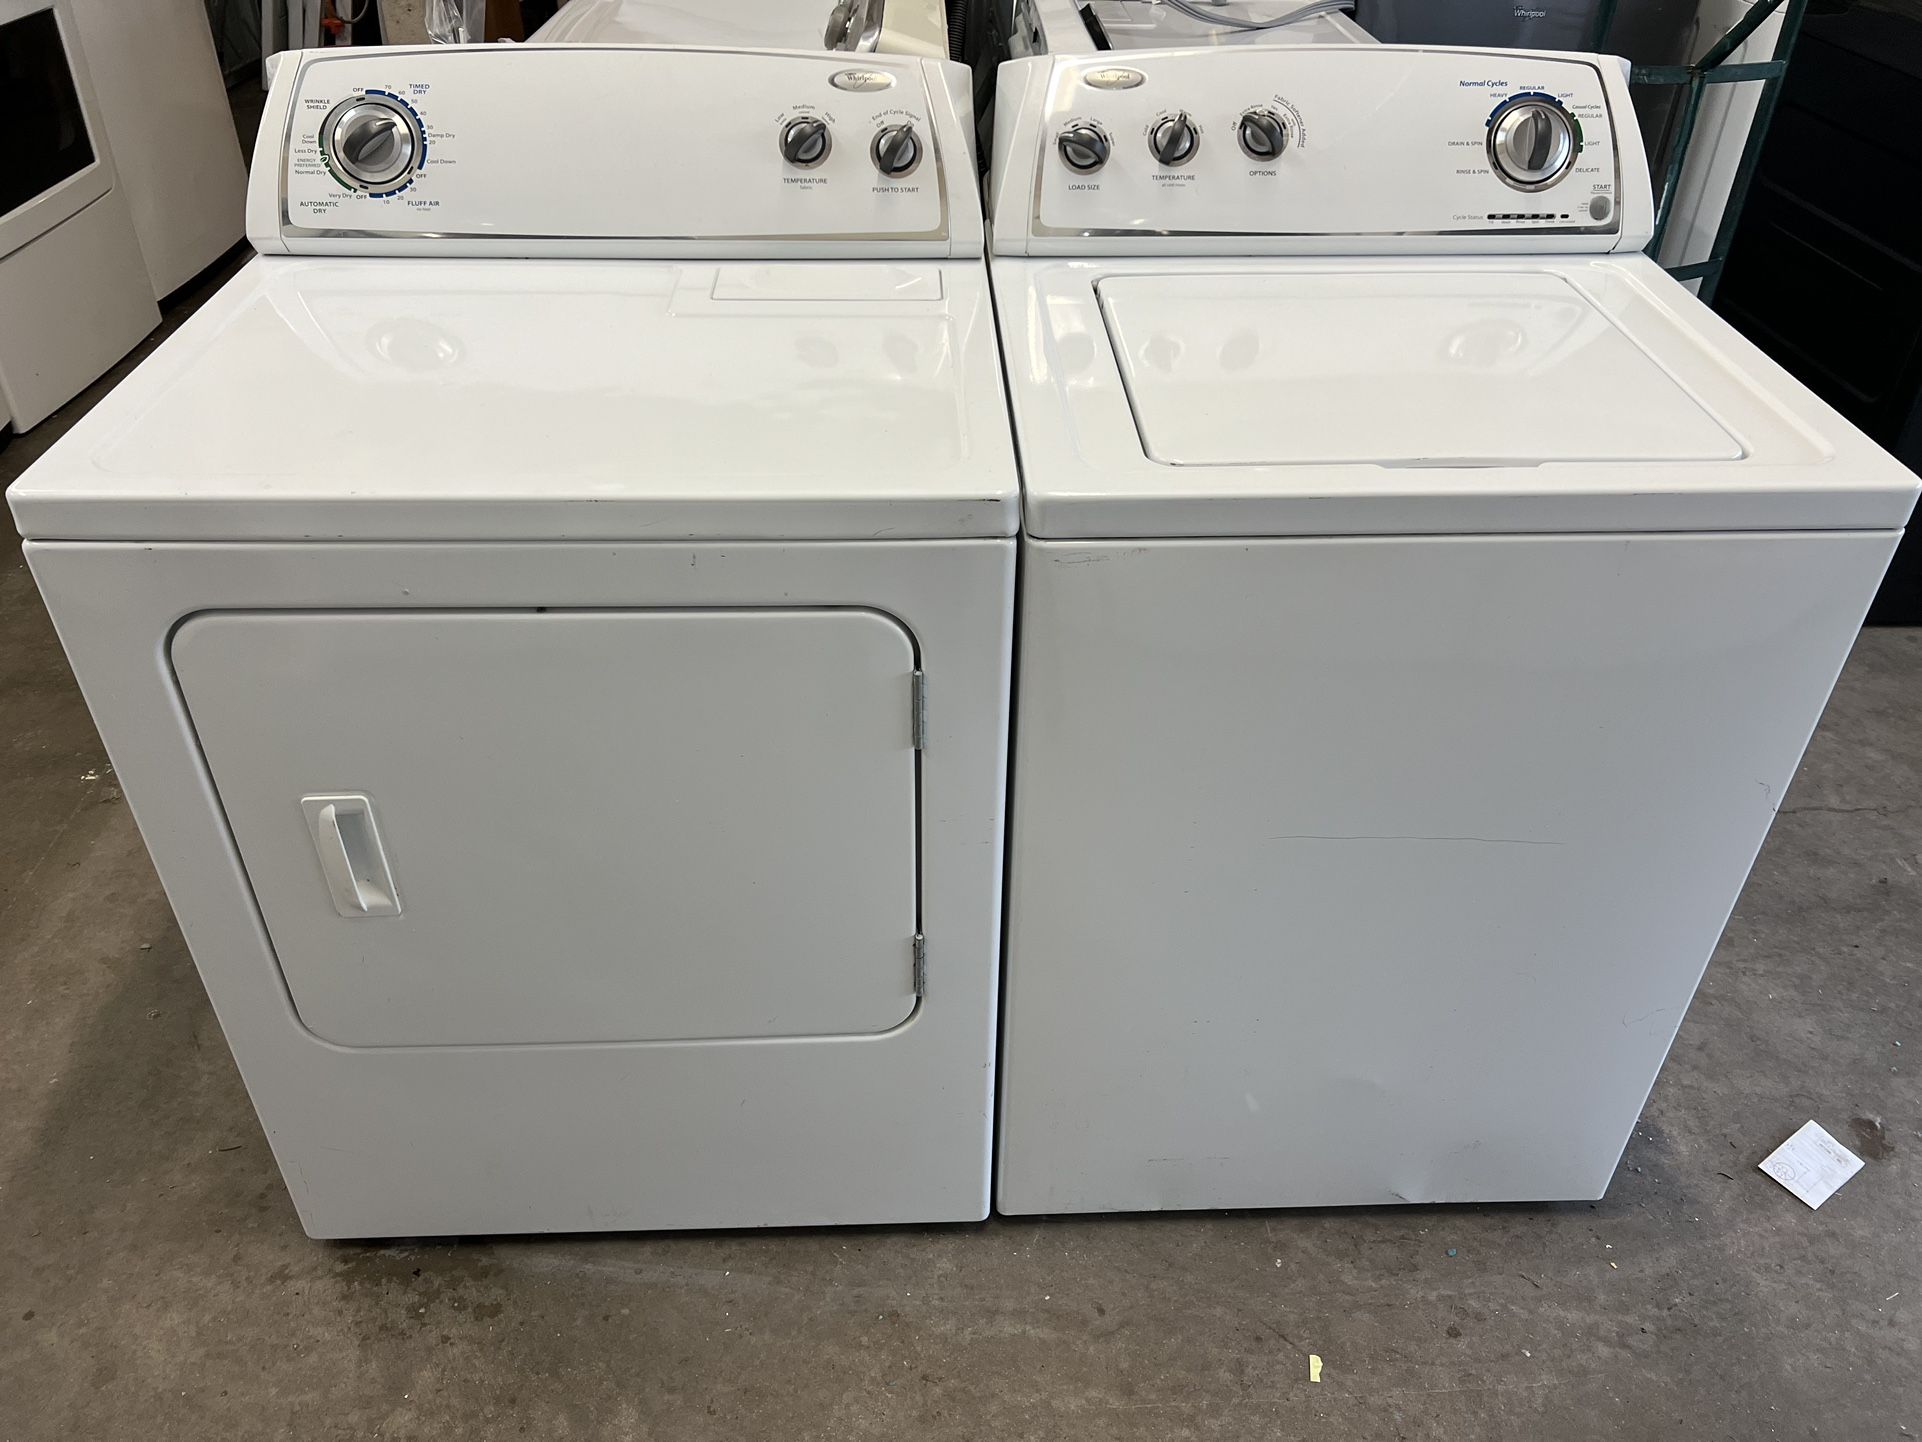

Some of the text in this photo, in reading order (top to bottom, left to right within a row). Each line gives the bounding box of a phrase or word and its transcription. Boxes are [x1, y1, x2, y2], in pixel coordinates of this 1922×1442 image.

[1514, 9, 1546, 18] Whirlpool
[1275, 94, 1290, 105] Fabric
[1290, 104, 1304, 127] Softener
[824, 112, 836, 124] High
[872, 112, 882, 121] End
[905, 111, 921, 122] Signal
[1090, 116, 1103, 125] Large
[876, 120, 885, 128] Off
